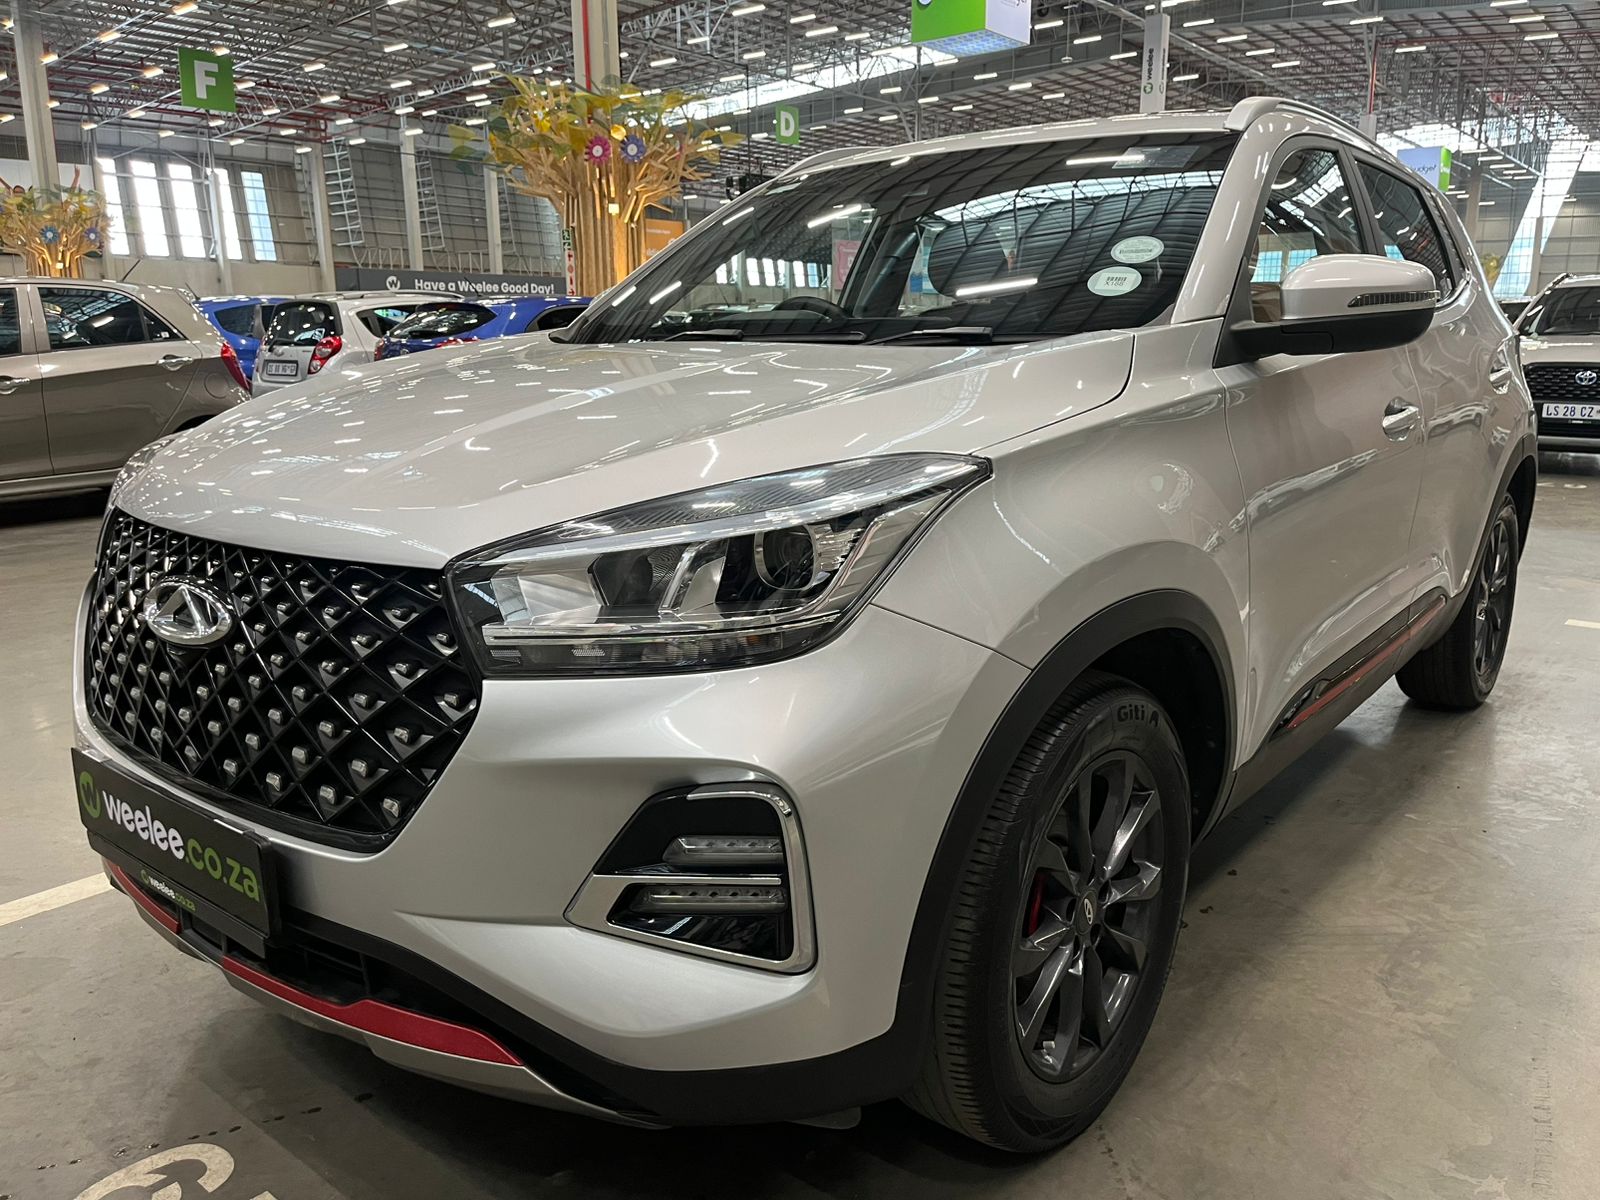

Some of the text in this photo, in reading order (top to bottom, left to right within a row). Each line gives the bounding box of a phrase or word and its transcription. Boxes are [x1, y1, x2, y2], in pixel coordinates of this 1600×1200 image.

[194, 60, 219, 99] F
[780, 111, 795, 137] D
[414, 279, 446, 290] Have
[447, 282, 456, 290] a
[457, 281, 499, 292] Weelee
[501, 282, 528, 293] Good
[531, 284, 555, 294] Day!
[1546, 405, 1594, 418] LS 28 CZ
[1117, 703, 1145, 722] Giti
[102, 790, 260, 902] weelee.co.za
